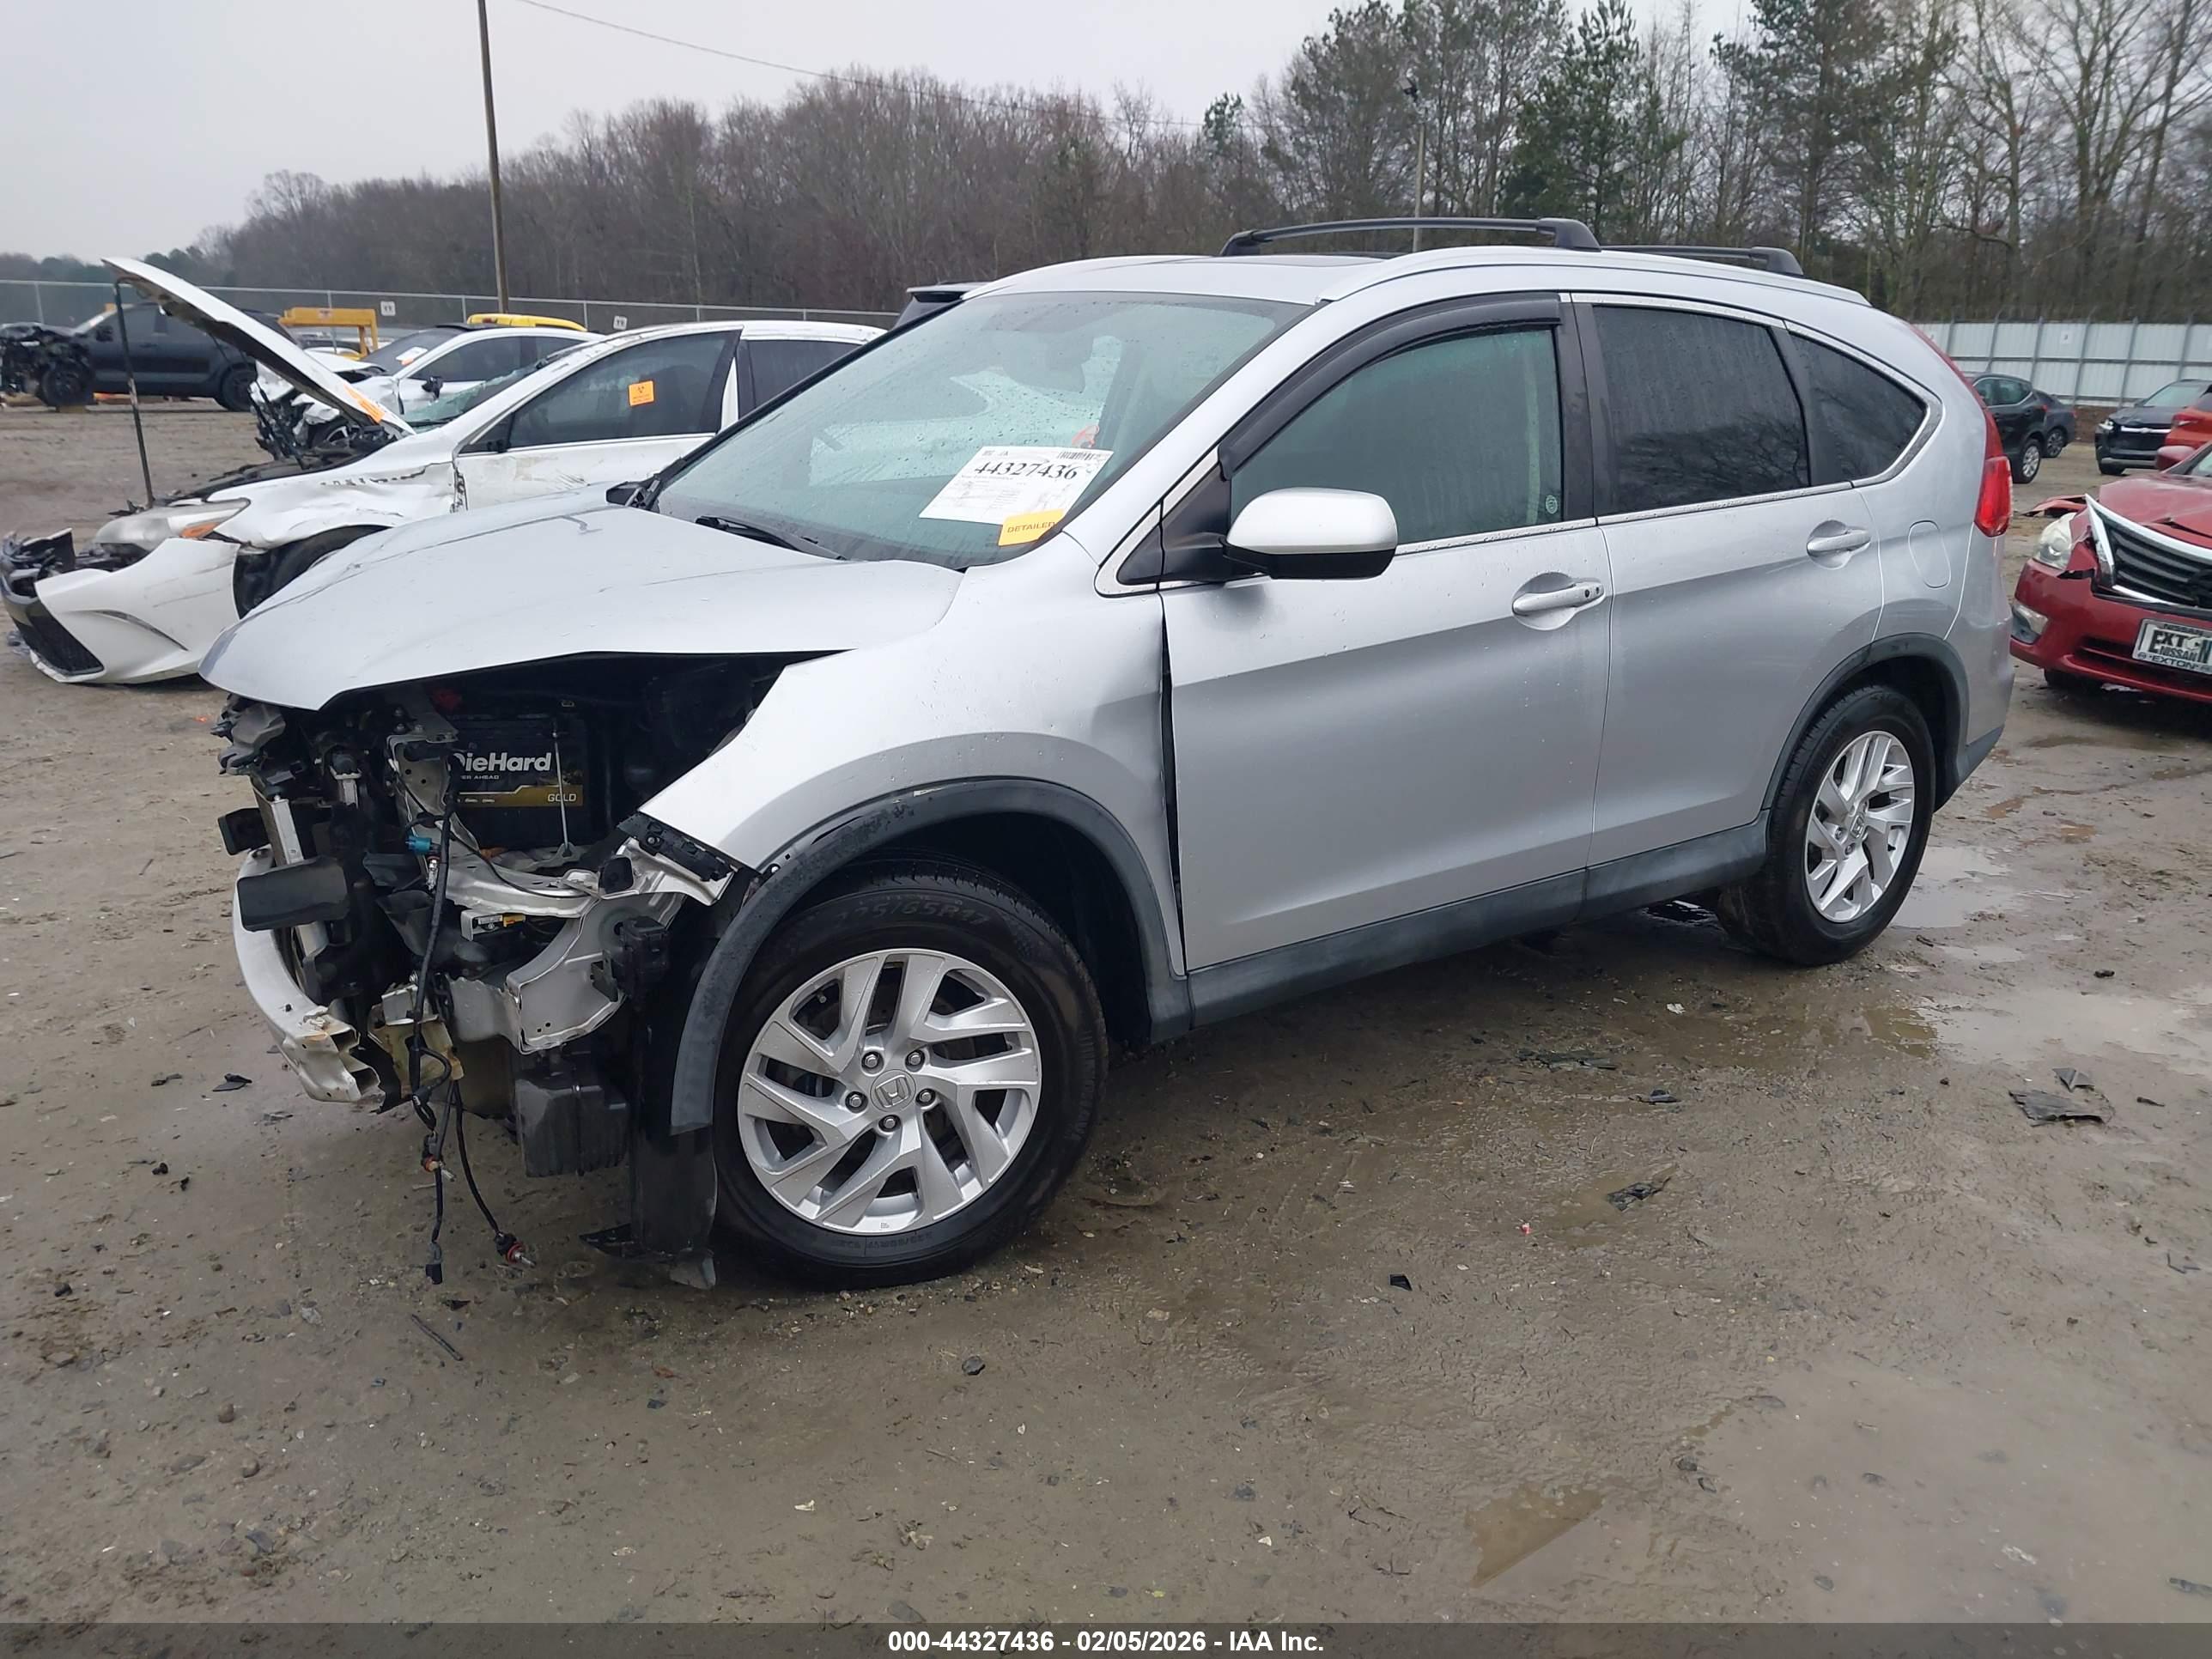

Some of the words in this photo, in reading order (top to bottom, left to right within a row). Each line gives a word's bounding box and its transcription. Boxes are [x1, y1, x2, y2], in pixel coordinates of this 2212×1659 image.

[975, 460, 1079, 481] 44327436
[1006, 520, 1056, 534] DETAILED
[2159, 645, 2198, 662] NISSAN
[547, 793, 577, 802] GOLD
